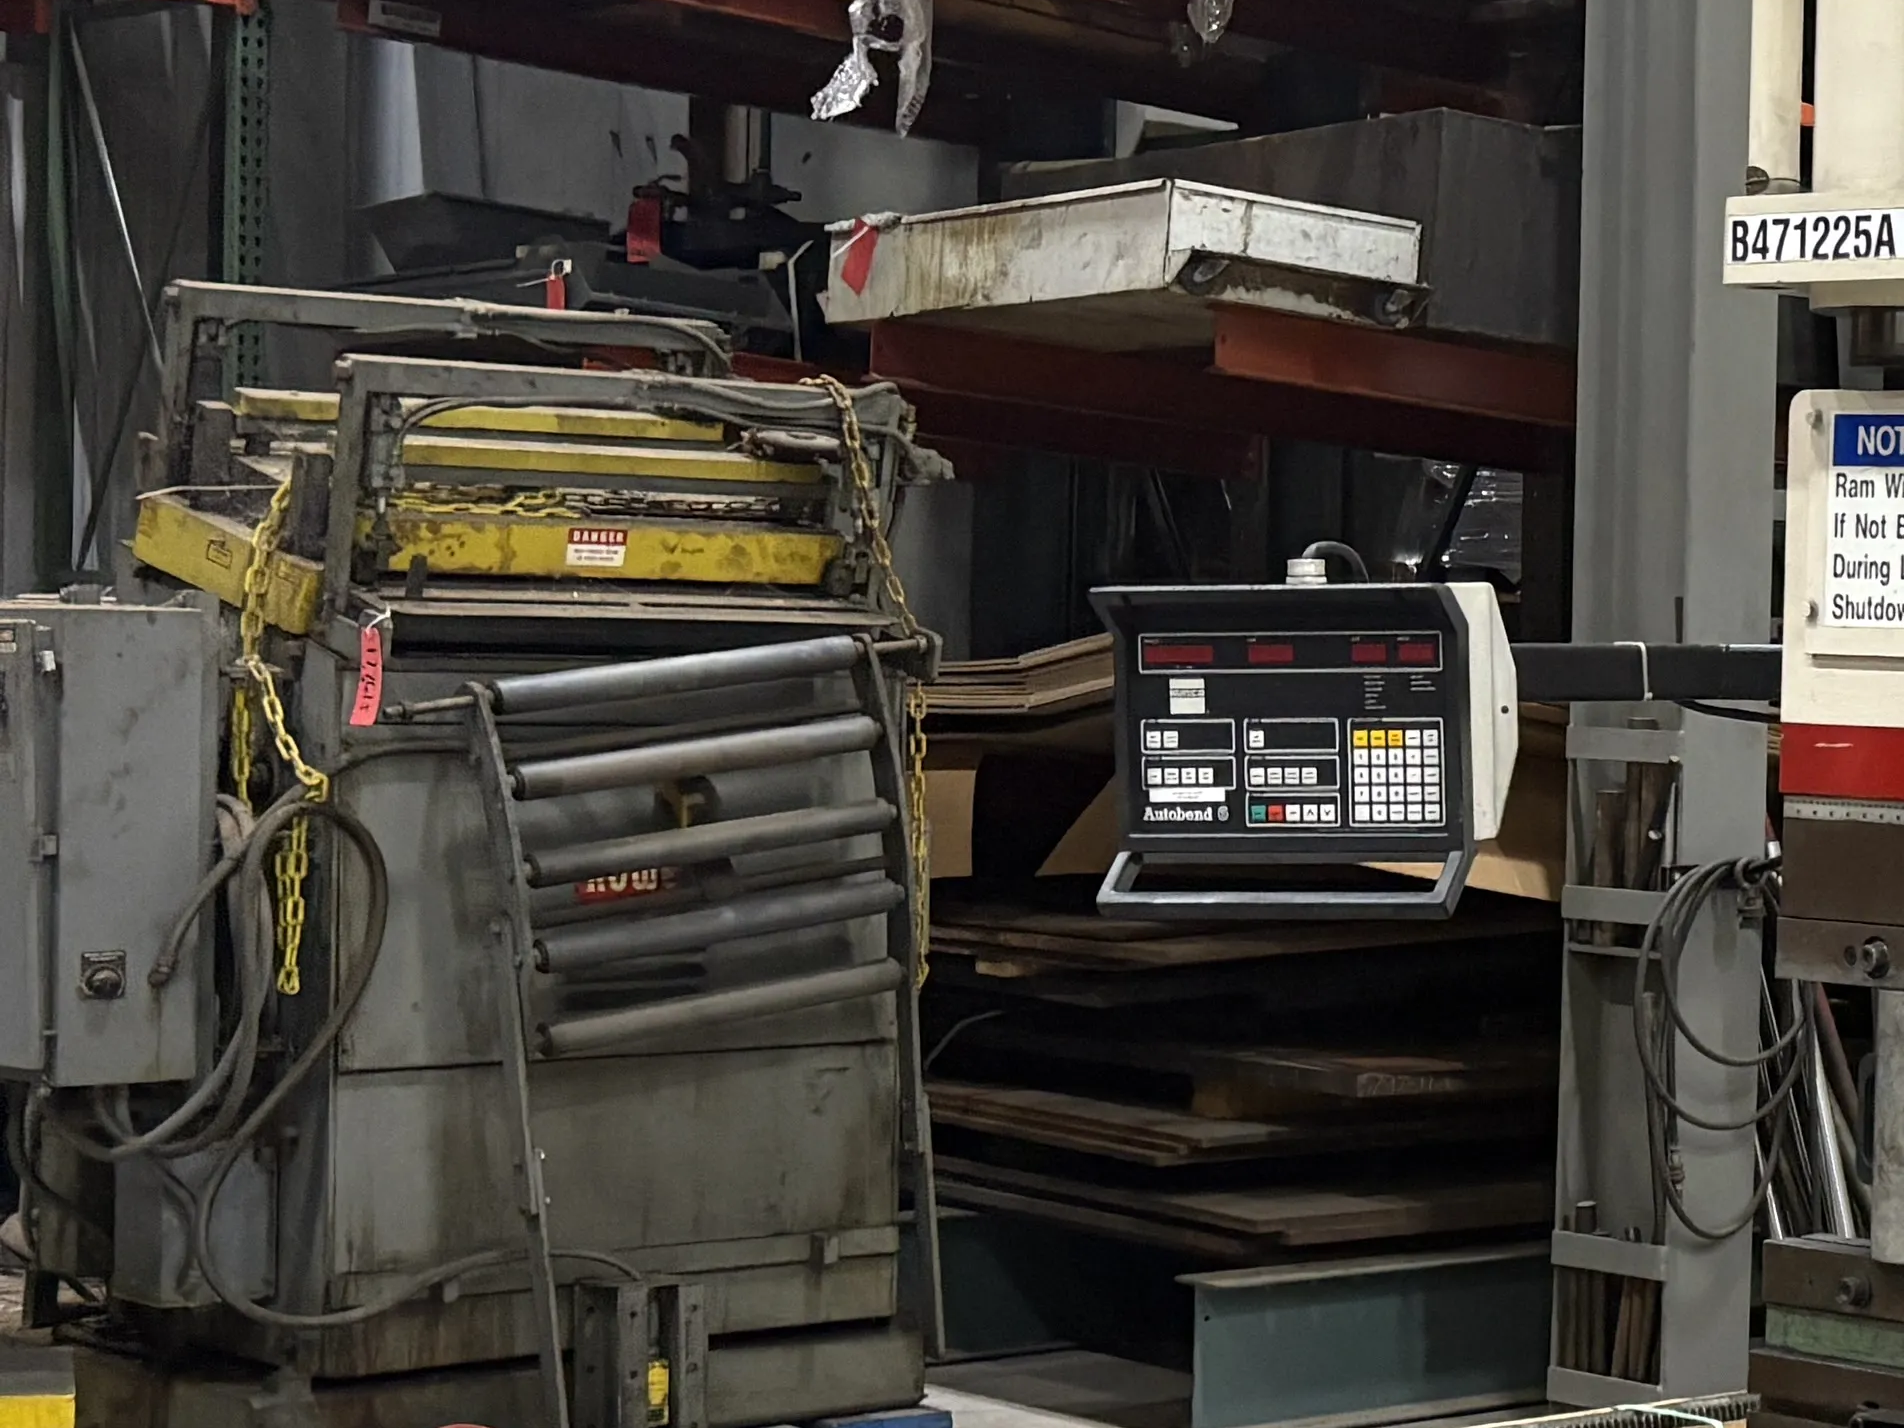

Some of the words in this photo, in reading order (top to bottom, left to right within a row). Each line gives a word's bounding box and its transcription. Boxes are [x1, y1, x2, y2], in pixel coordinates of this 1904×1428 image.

[1731, 213, 1897, 262] B471225A
[1835, 472, 1875, 499] Ram
[573, 530, 625, 542] DANGER
[1834, 512, 1846, 539] If
[1855, 513, 1887, 539] Not
[1832, 553, 1891, 586] During
[1143, 806, 1213, 821] Autobend
